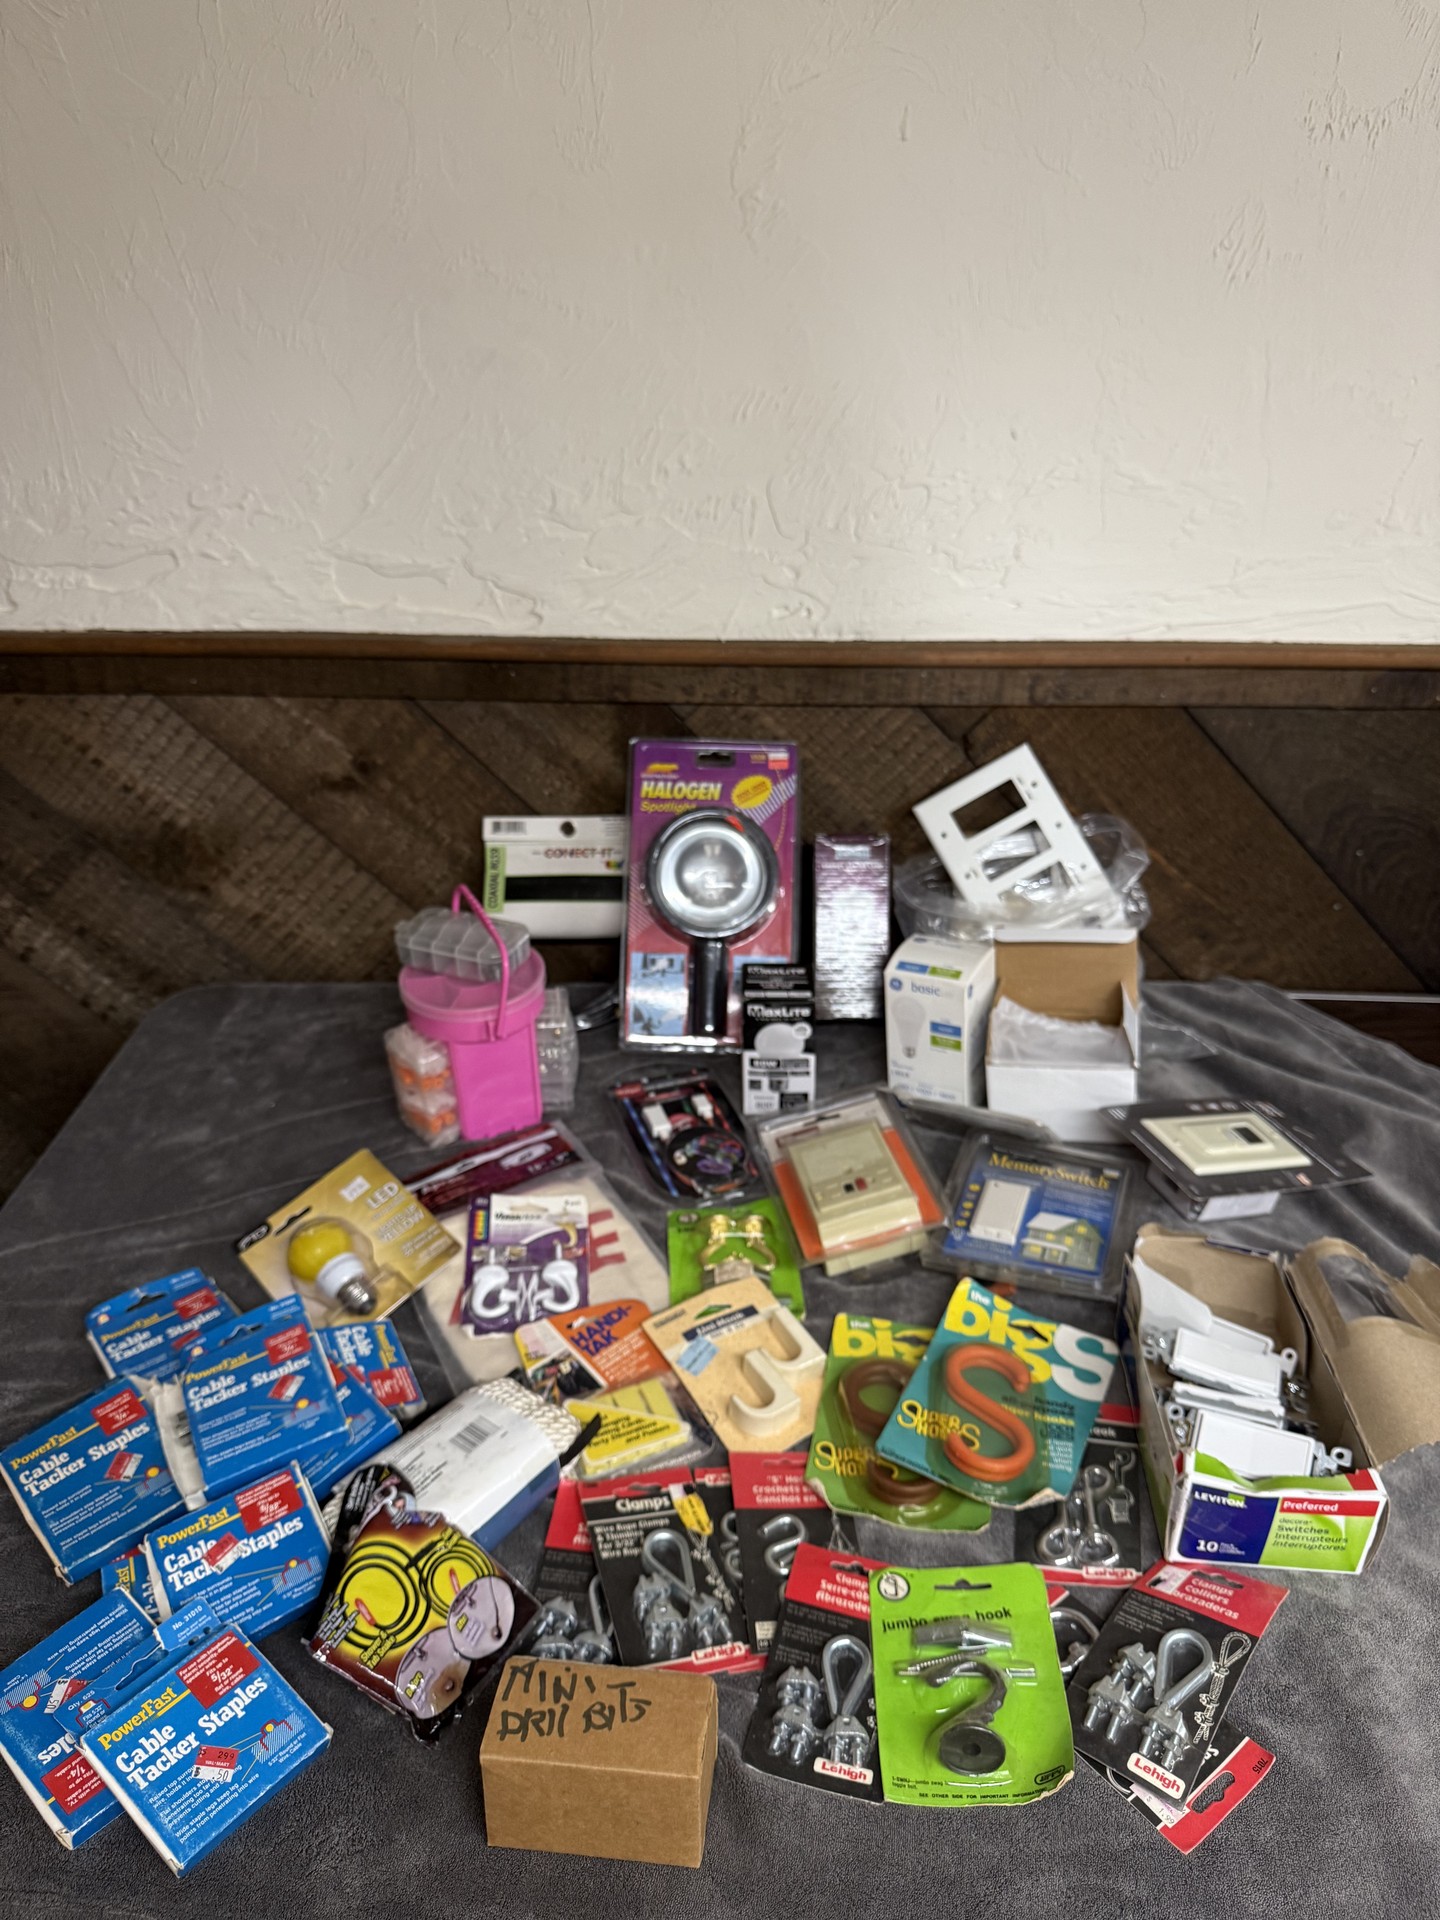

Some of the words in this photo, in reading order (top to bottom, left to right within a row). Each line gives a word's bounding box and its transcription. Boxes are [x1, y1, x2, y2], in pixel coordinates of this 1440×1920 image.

[640, 781, 722, 800] HALOGEN
[911, 981, 941, 997] basic
[747, 1004, 811, 1018] MaxLite
[366, 1180, 399, 1210] LED
[970, 1290, 990, 1305] the
[108, 1332, 164, 1364] Tacker
[164, 1306, 221, 1339] Staples
[850, 1320, 870, 1329] the
[944, 1280, 1056, 1383] big
[105, 1328, 151, 1354] Cable
[581, 1327, 619, 1358] TAK
[183, 1351, 248, 1384] PowerFast
[185, 1371, 236, 1401] Cable
[189, 1379, 249, 1413] Tacker
[250, 1354, 311, 1388] Staples
[9, 1425, 78, 1470] PowerFast
[23, 1454, 87, 1498] Tacker
[87, 1419, 151, 1462] Staples
[17, 1448, 70, 1485] Cable
[615, 1495, 670, 1513] Clamps
[1194, 1491, 1245, 1508] LEVITON
[1283, 1501, 1338, 1512] Preferred
[156, 1506, 229, 1549] PowerFast
[235, 1514, 304, 1558] Staples
[1275, 1533, 1348, 1543] Interrupteurs
[1277, 1525, 1329, 1534] Switches
[161, 1534, 219, 1574] Cable
[1196, 1540, 1218, 1552] 10
[1272, 1540, 1346, 1550] Interruptores
[834, 1572, 868, 1589] Clamp
[1191, 1577, 1233, 1596] Clamps
[815, 1590, 870, 1612] Abrazade
[1170, 1589, 1238, 1618] brazaderas
[1184, 1585, 1229, 1604] Colliers
[171, 1618, 184, 1630] No.
[183, 1604, 203, 1621] 31010
[883, 1617, 928, 1632] jumbo
[976, 1607, 1012, 1621] hook
[196, 1653, 207, 1662] with
[359, 1635, 383, 1662] Shower
[378, 1629, 388, 1639] &
[366, 1654, 380, 1669] Tub
[376, 1634, 396, 1657] Snake
[205, 1666, 216, 1676] Fits
[215, 1661, 223, 1669] up
[209, 1661, 236, 1685] 5/32"
[213, 1682, 223, 1691] flat
[228, 1667, 243, 1680] round
[217, 1683, 231, 1695] wire,
[229, 1671, 245, 1685] cable.
[97, 1684, 177, 1751] PowerFast
[583, 1682, 652, 1734] BITS
[126, 1727, 200, 1792] Tacker
[197, 1673, 268, 1737] Staples
[35, 1733, 76, 1767] ples
[113, 1720, 178, 1775] Cable
[82, 1769, 93, 1779] Fits
[212, 1768, 228, 1781] .50
[820, 1761, 867, 1780] Lehigh
[1133, 1757, 1181, 1791] Lehigh
[1251, 1756, 1267, 1774] 7015
[67, 1797, 78, 1806] TV,
[77, 1788, 90, 1799] with
[148, 1786, 167, 1803] Raised
[166, 1779, 177, 1789] top
[152, 1795, 167, 1809] wire,
[165, 1783, 182, 1797] holds
[159, 1806, 171, 1818] Flat
[170, 1785, 197, 1809] shoulders
[162, 1795, 193, 1823] penetrating
[193, 1788, 203, 1798] too
[202, 1782, 211, 1790] far
[166, 1806, 191, 1828] prevents
[190, 1791, 210, 1808] cutting
[208, 1782, 220, 1793] and
[174, 1823, 189, 1837] Wide
[188, 1810, 206, 1825] staple
[204, 1800, 217, 1812] legs
[216, 1789, 230, 1802] keep
[228, 1782, 239, 1791] leg
[178, 1827, 196, 1844] points
[196, 1815, 209, 1828] from
[208, 1791, 239, 1817] penetrating
[237, 1782, 248, 1792] into
[247, 1773, 259, 1783] wire
[1158, 1808, 1175, 1824] 1.99
